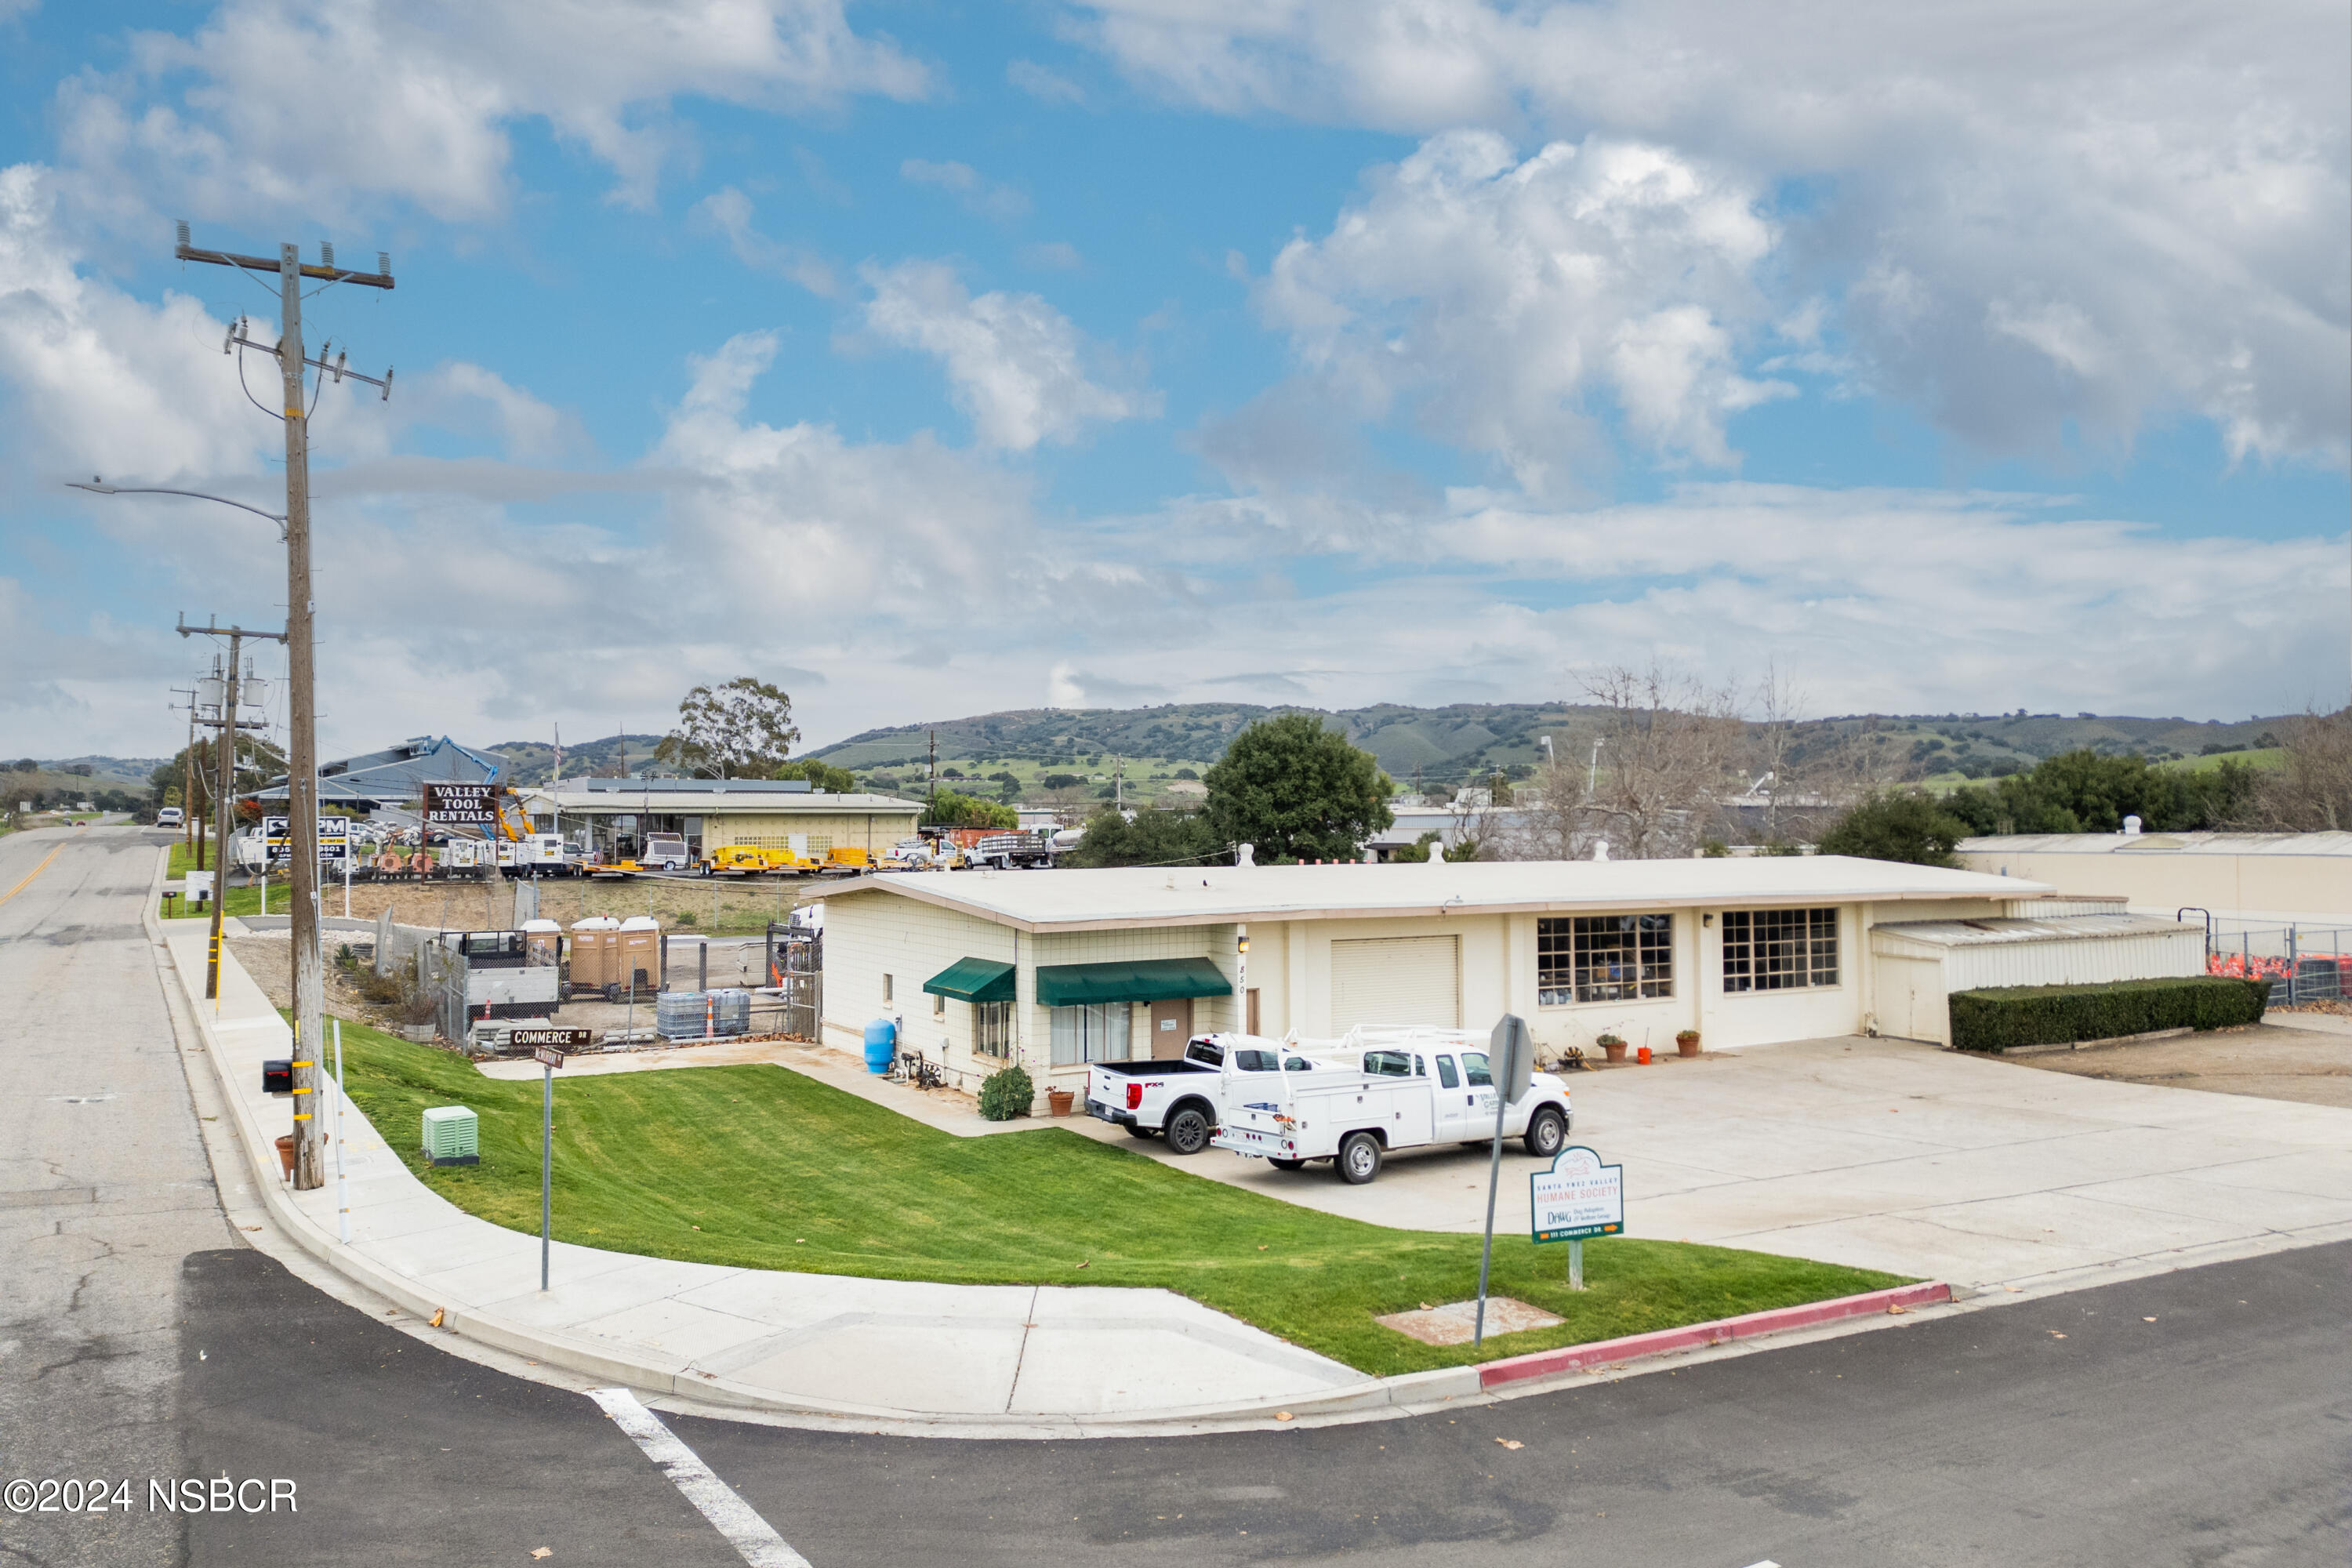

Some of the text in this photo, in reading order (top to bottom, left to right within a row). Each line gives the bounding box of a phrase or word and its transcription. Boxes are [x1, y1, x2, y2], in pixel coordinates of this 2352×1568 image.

[434, 786, 492, 797] VALLEY
[441, 799, 483, 809] TOOL
[429, 811, 494, 821] RENTALS
[514, 1031, 572, 1044] COMMERCE
[1537, 1186, 1617, 1203] HUMANE SOCIETY
[1559, 1227, 1592, 1237] COMMERCE
